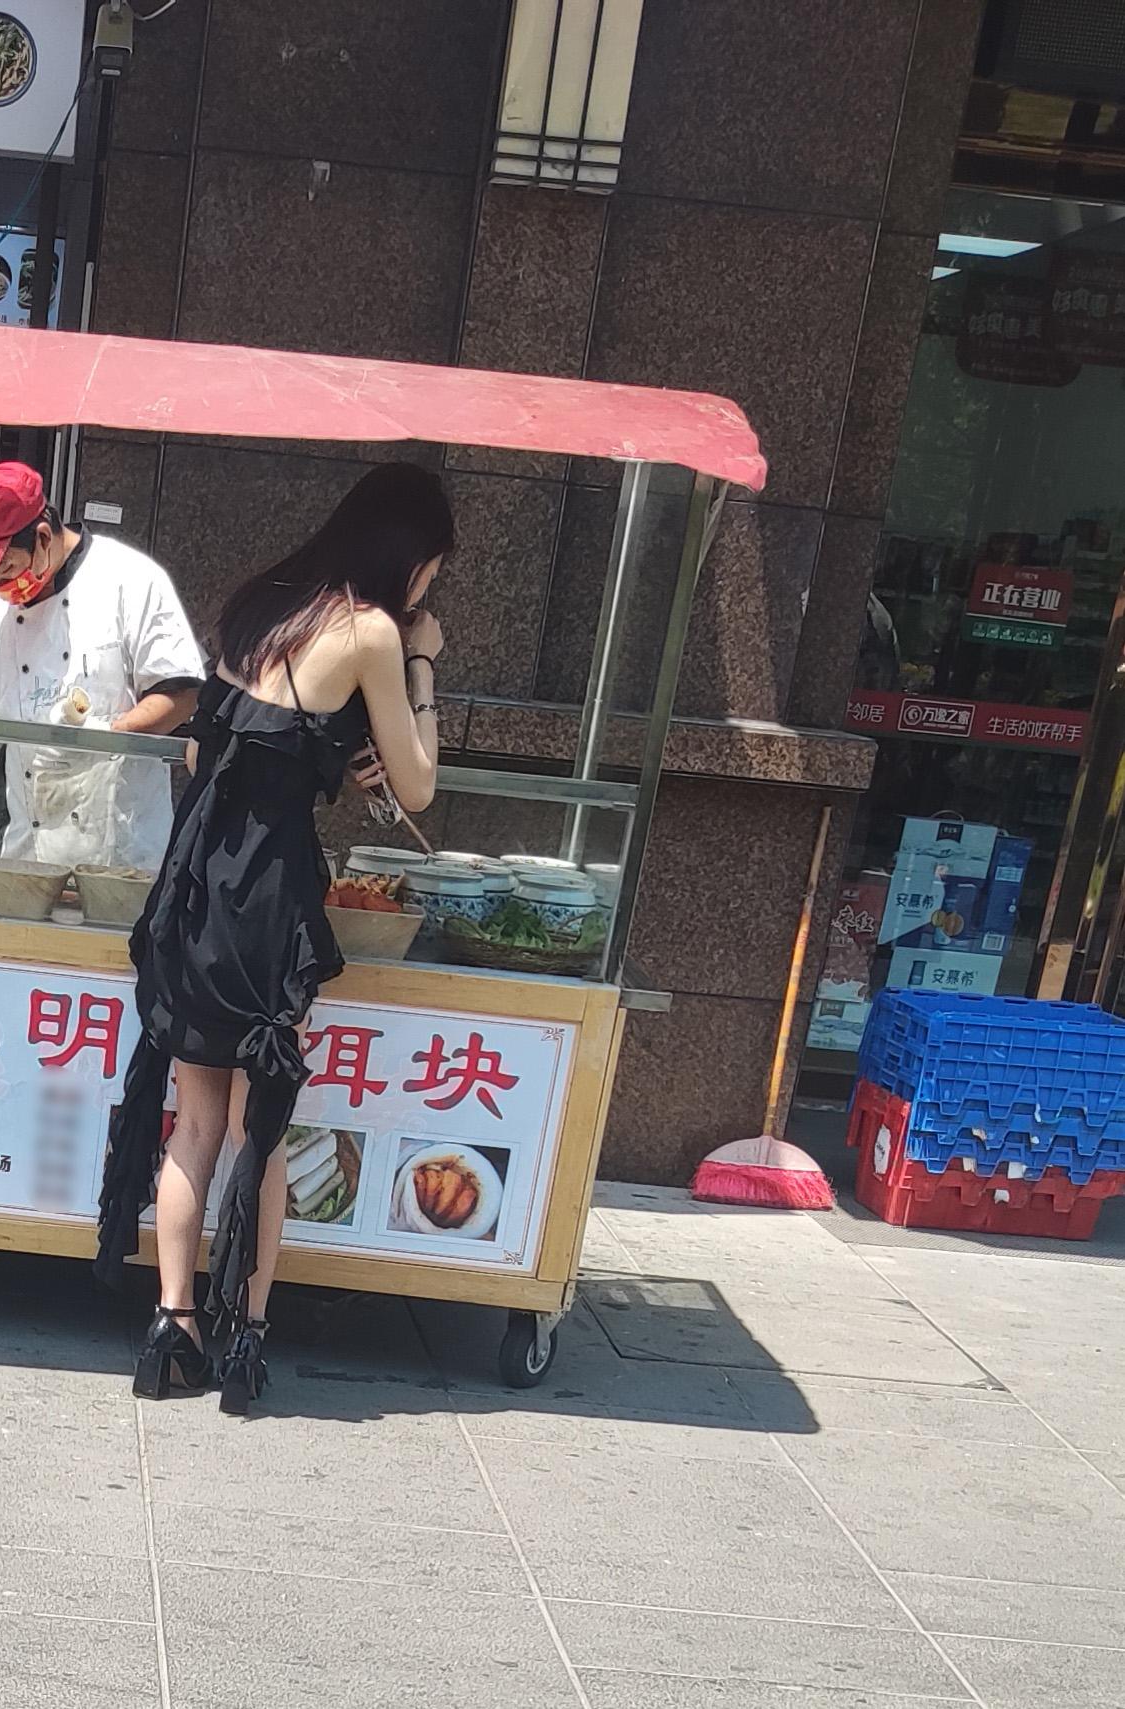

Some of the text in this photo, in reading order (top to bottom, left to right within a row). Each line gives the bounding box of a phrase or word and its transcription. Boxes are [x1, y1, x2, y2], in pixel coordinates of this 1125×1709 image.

[982, 582, 1062, 611] 正在营业
[986, 716, 1082, 742] 生活的好帮手
[896, 892, 936, 910] 安慕希
[931, 967, 976, 987] 安慕希
